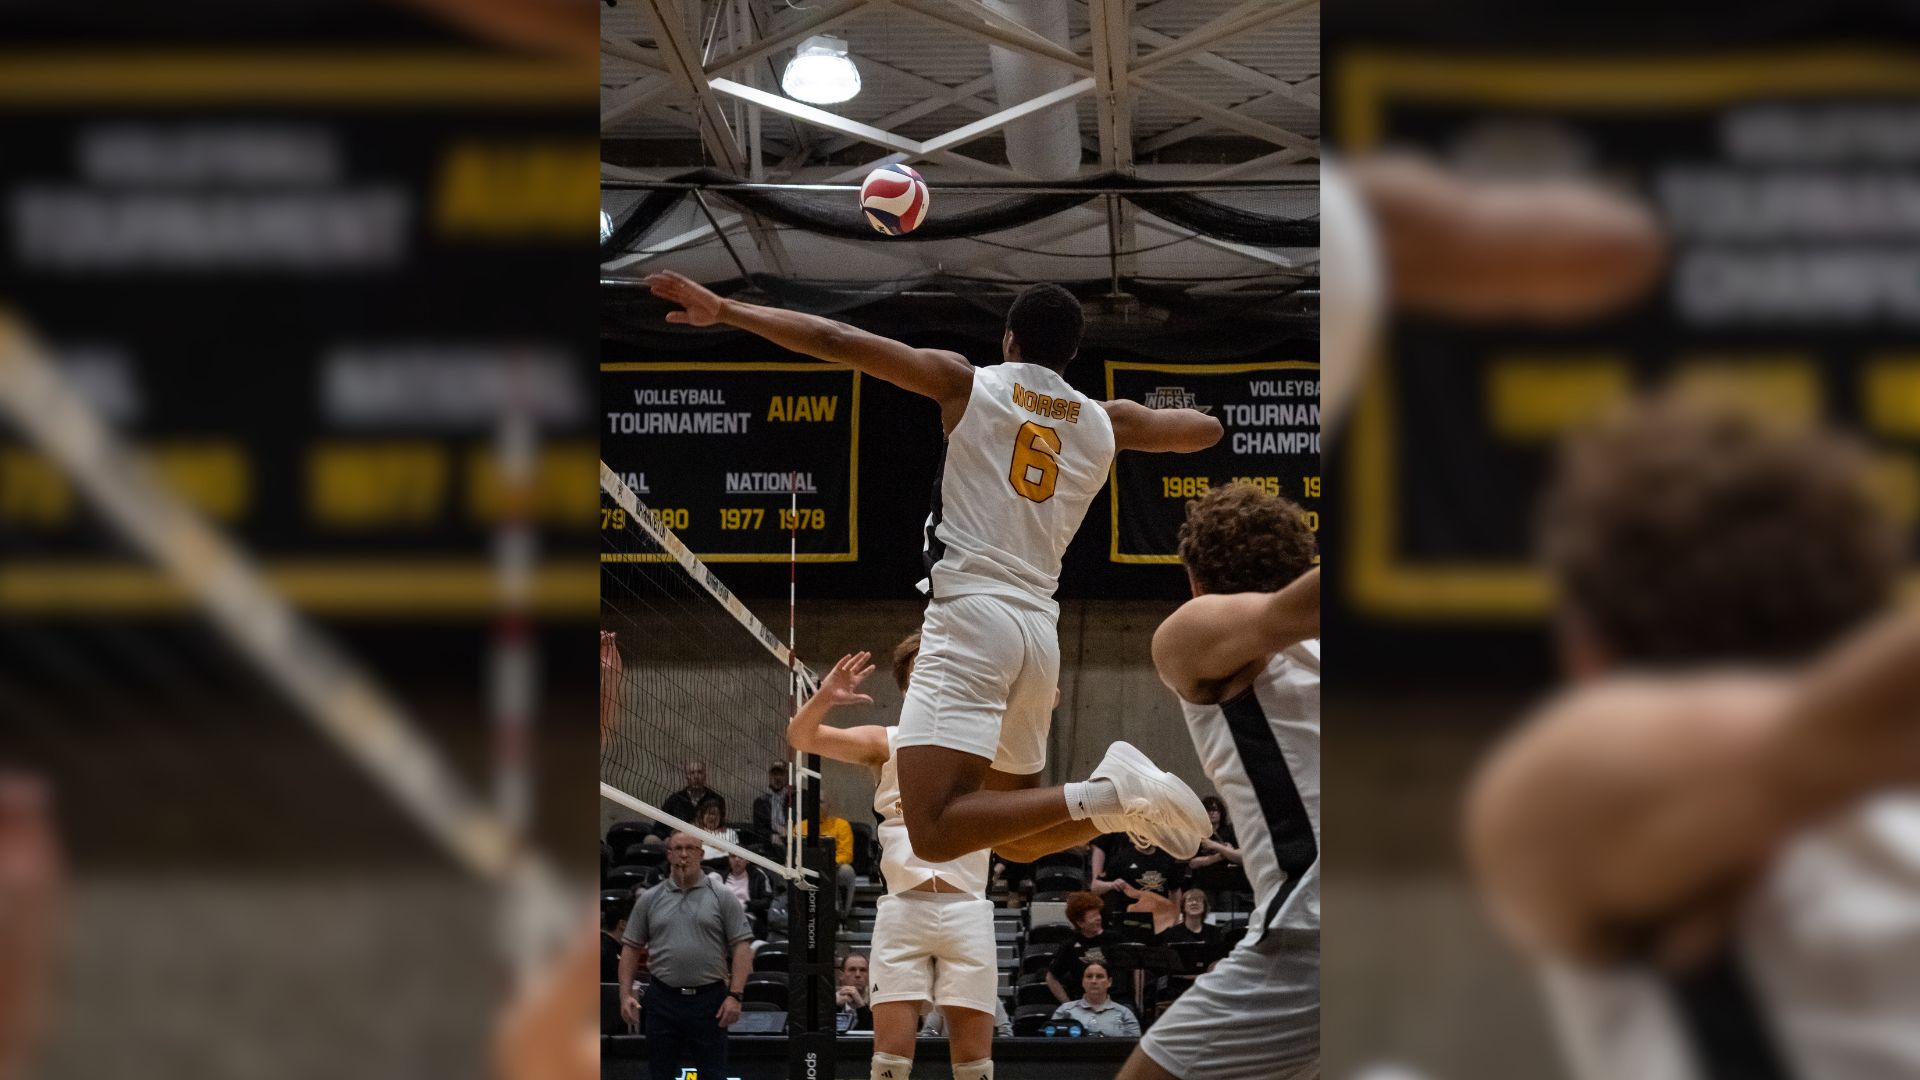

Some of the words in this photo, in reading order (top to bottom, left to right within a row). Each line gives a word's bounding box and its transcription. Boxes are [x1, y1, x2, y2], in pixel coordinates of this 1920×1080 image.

[634, 389, 725, 405] VOLLEYBALL
[1012, 383, 1081, 423] NORSE
[767, 396, 838, 422] AIAW
[607, 412, 751, 434] TOURNAMENT
[1008, 420, 1062, 503] 6
[726, 473, 817, 491] NATIONAL
[1162, 476, 1209, 498] 1985
[720, 508, 764, 530] 1977
[779, 508, 825, 530] 1978
